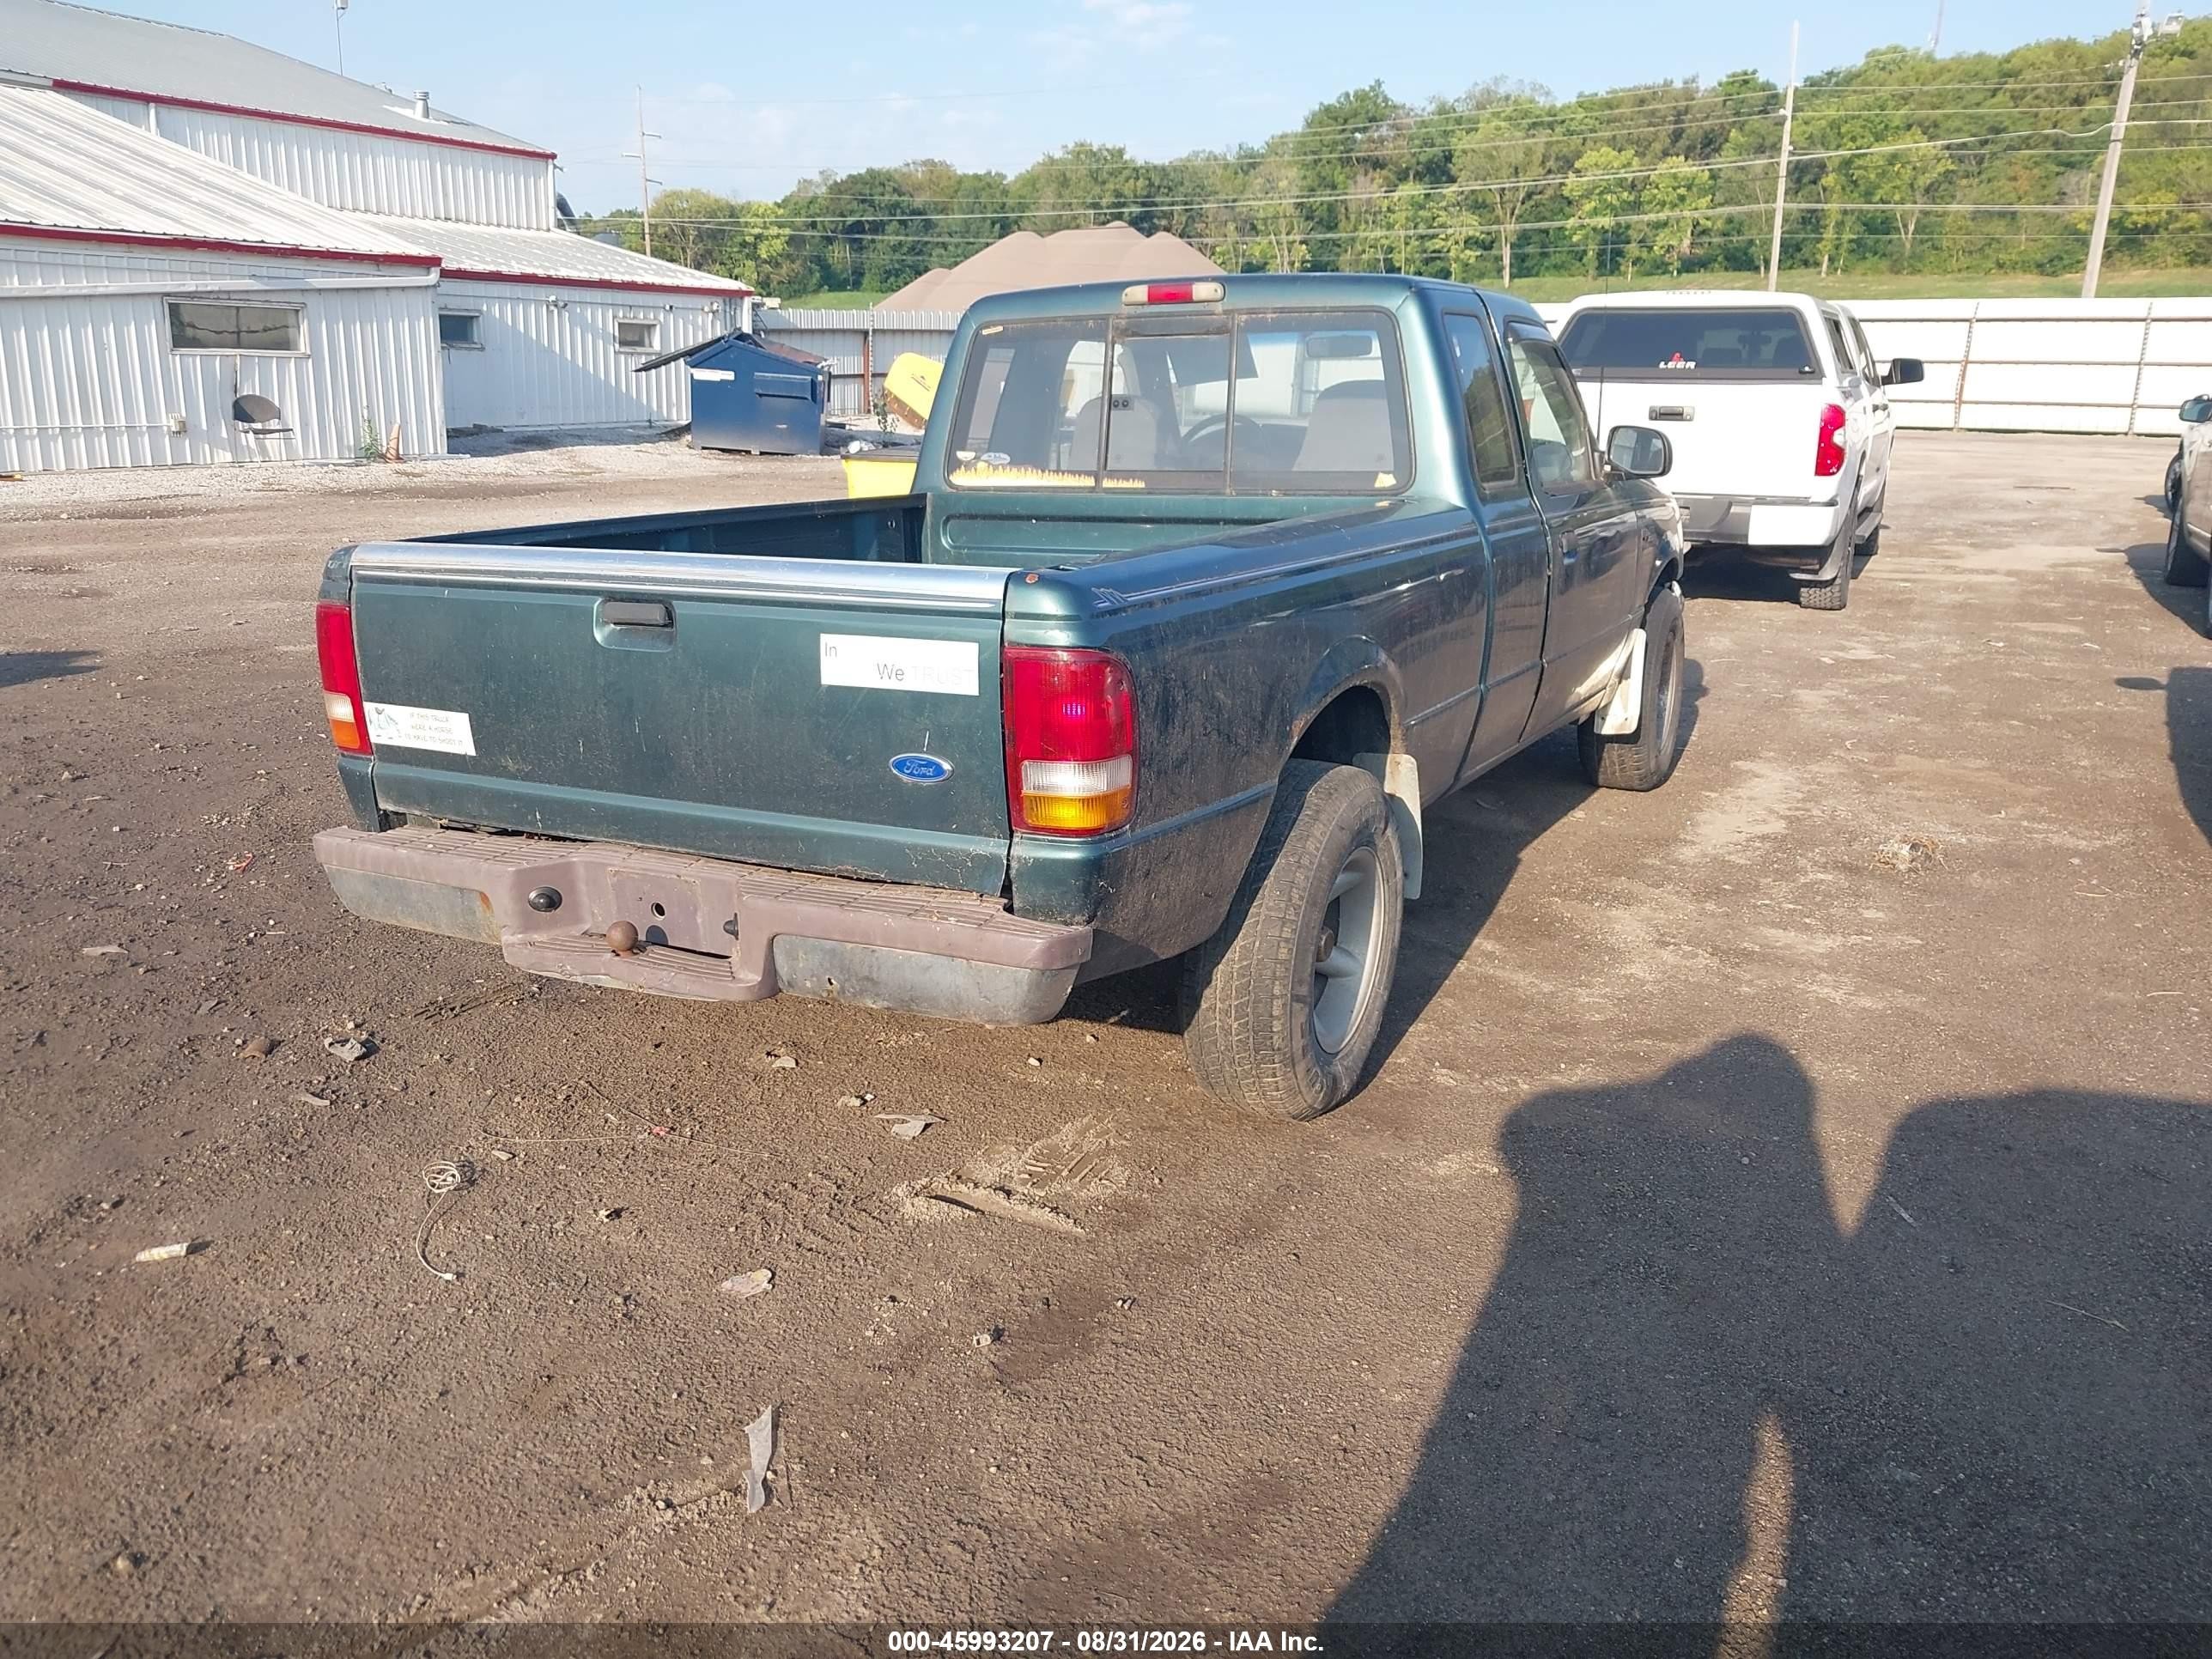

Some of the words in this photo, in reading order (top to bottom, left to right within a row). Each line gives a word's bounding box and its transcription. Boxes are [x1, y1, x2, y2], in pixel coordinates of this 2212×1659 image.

[1659, 361, 1697, 370] LEER
[824, 642, 838, 658] In
[877, 662, 905, 682] We
[911, 665, 975, 687] TRUST
[903, 758, 937, 776] Ford
